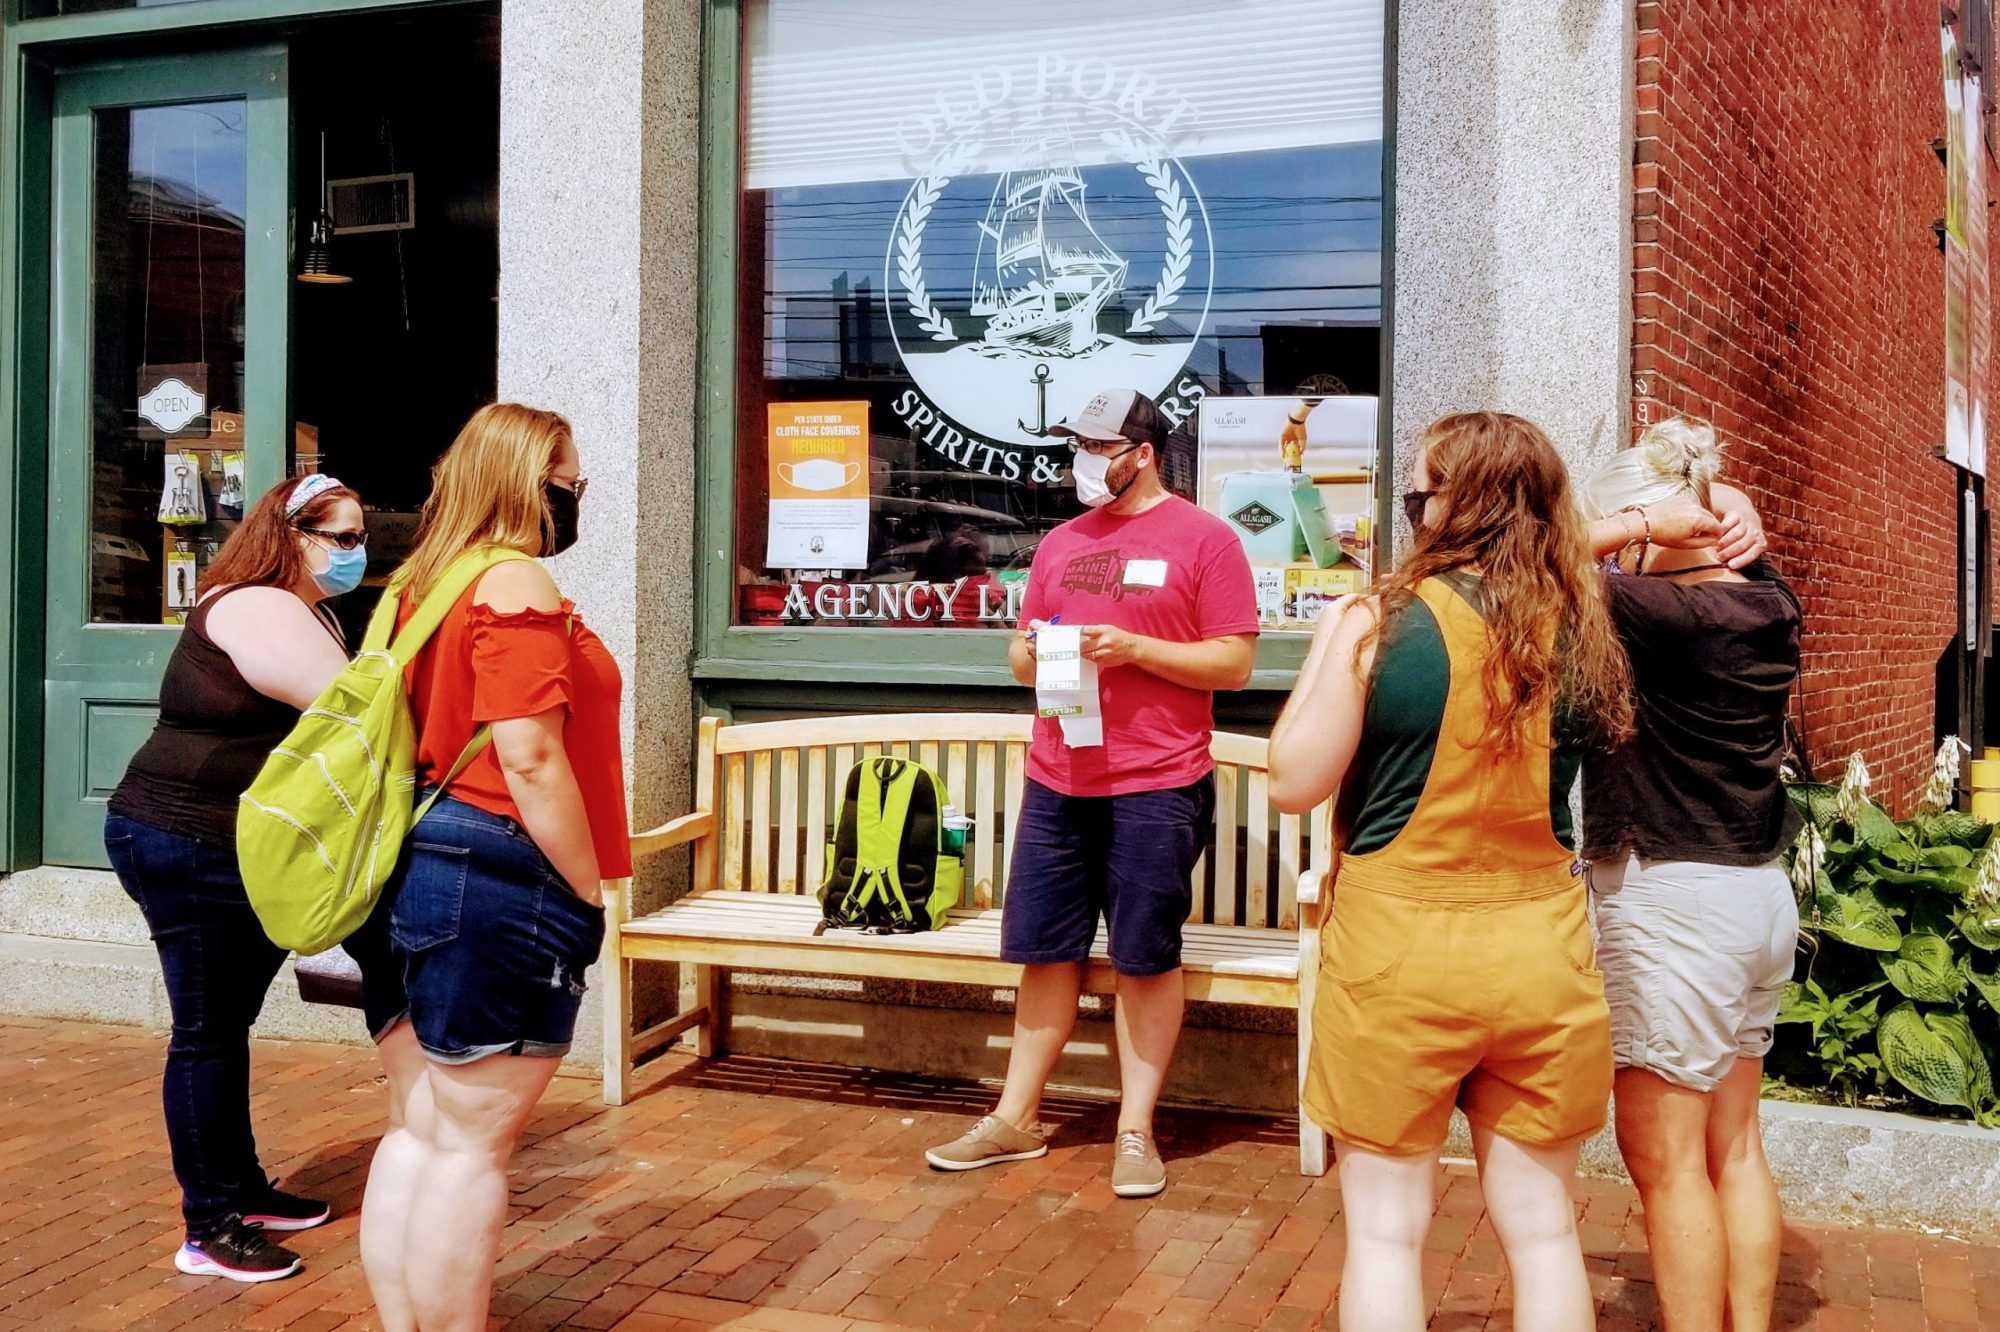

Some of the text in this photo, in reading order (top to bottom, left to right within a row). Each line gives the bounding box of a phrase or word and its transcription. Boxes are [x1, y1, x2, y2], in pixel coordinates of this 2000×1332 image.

[894, 52, 1200, 157] OLD PORT
[153, 396, 190, 413] OPEN
[806, 415, 823, 424] STATE
[1214, 416, 1247, 425] ALLAGASH
[775, 425, 861, 438] CLOTH FACE COVERINGS
[891, 389, 1022, 481] SPIRITS
[1031, 454, 1064, 483] &
[792, 439, 846, 456] REQUIRED
[1240, 513, 1272, 524] ALLAGASH
[1066, 562, 1108, 575] MAINE
[1087, 575, 1104, 585] BUS
[779, 577, 968, 622] AGENCY
[1046, 705, 1077, 716] HELLO
